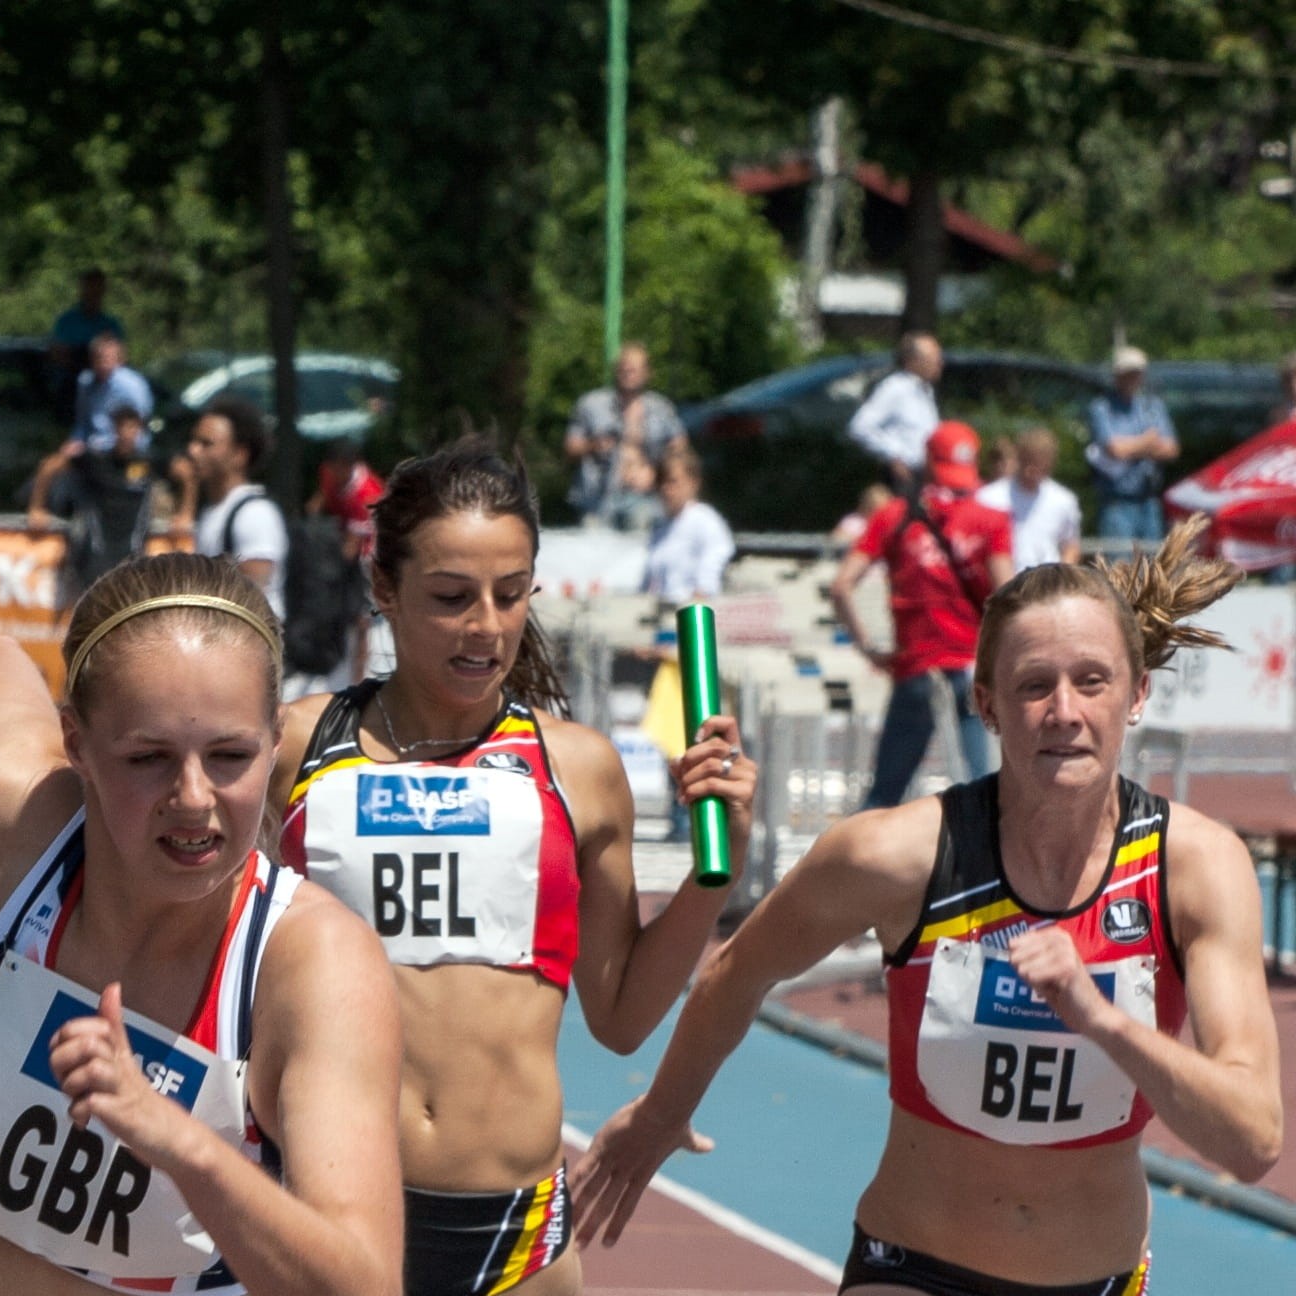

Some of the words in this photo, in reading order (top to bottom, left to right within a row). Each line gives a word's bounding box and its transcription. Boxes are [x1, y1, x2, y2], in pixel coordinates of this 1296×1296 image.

[372, 852, 476, 937] BEL
[992, 1002, 1010, 1015] The
[980, 1040, 1084, 1124] BEL
